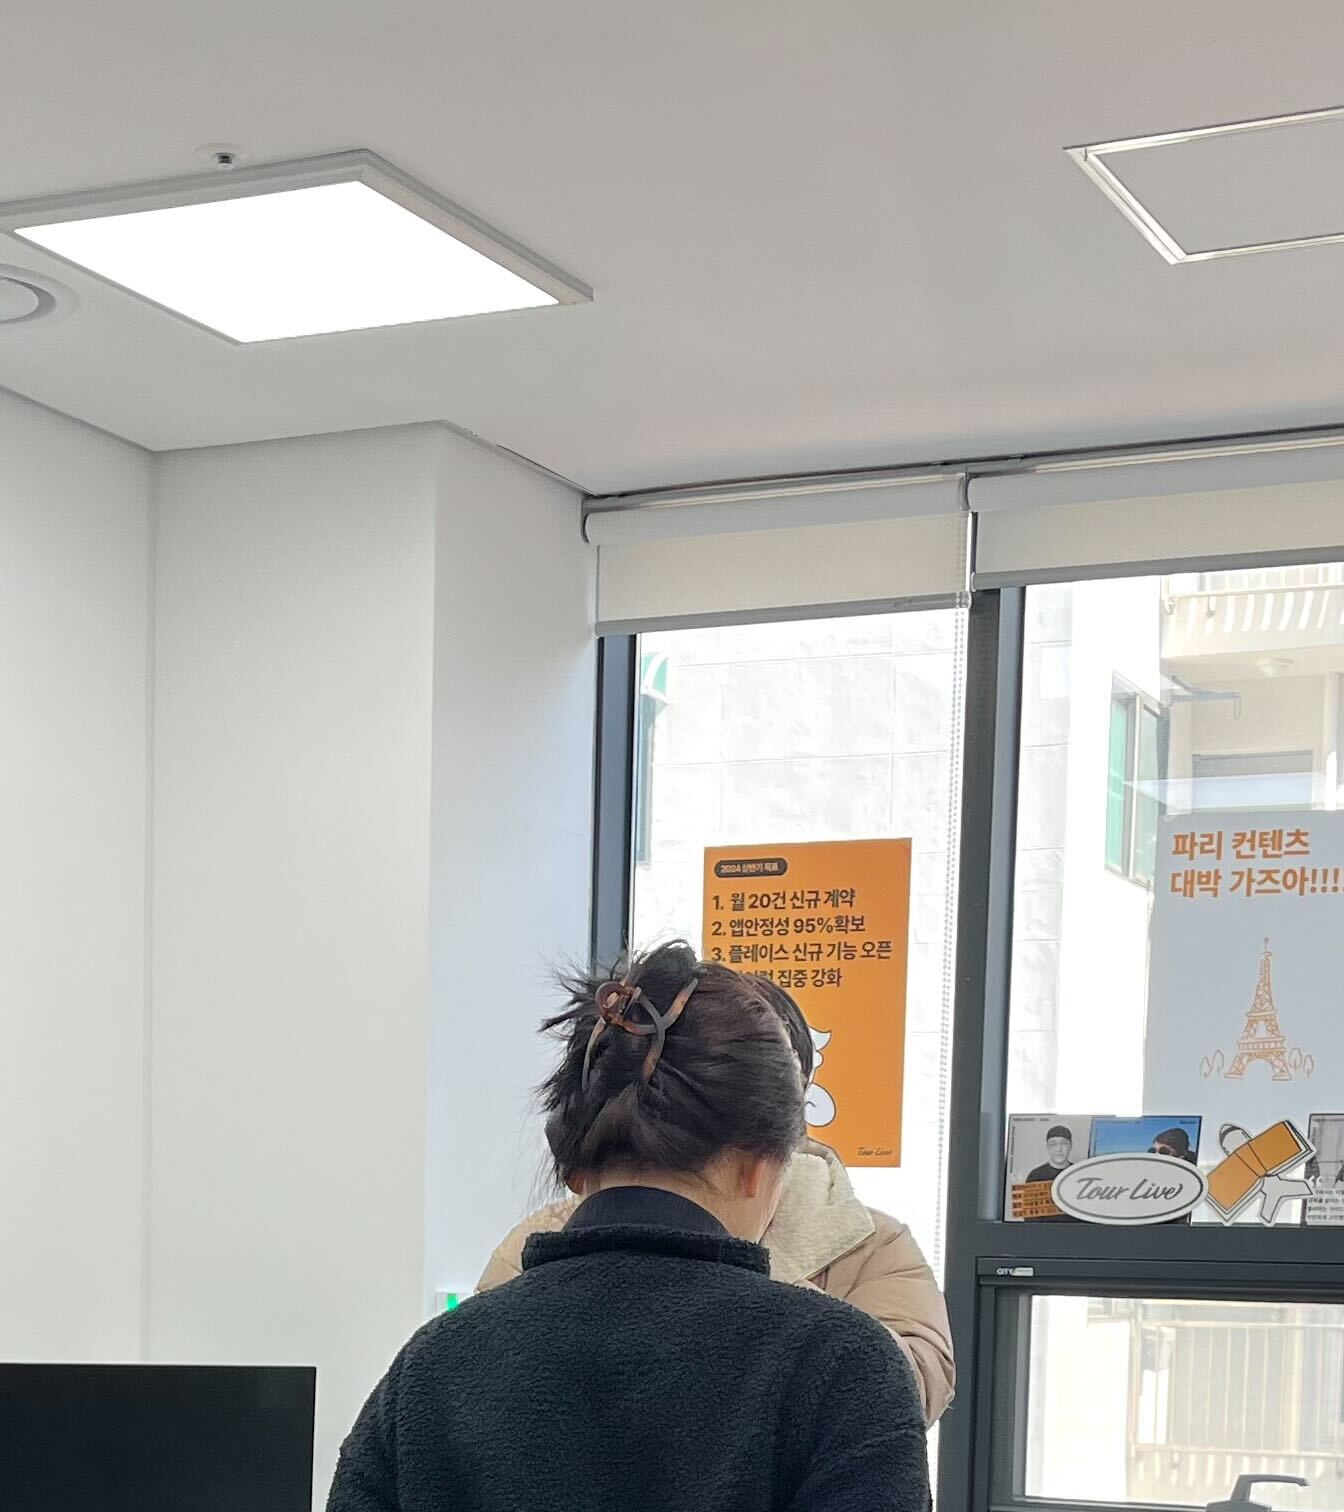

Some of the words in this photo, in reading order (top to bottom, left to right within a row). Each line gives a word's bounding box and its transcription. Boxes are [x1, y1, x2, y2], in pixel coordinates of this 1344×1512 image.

[1171, 830, 1223, 860] 파리
[1231, 828, 1310, 860] 컨텐츠
[1170, 868, 1222, 898] 대박
[712, 895, 724, 910] 1.
[730, 892, 745, 912] 월
[748, 891, 786, 909] 20건
[790, 890, 820, 909] 신규
[824, 888, 856, 908] 계약
[711, 921, 727, 936] 2.
[729, 917, 790, 938] 앱안정성
[711, 947, 726, 962] 3.
[729, 943, 789, 963] 플레이스
[792, 942, 823, 962] 신규
[827, 941, 856, 961] 기능
[860, 940, 892, 960] 오픈
[777, 969, 807, 988] 집중
[811, 968, 842, 987] 강화
[1075, 1177, 1126, 1200] Tour
[1128, 1178, 1183, 1200] Live
